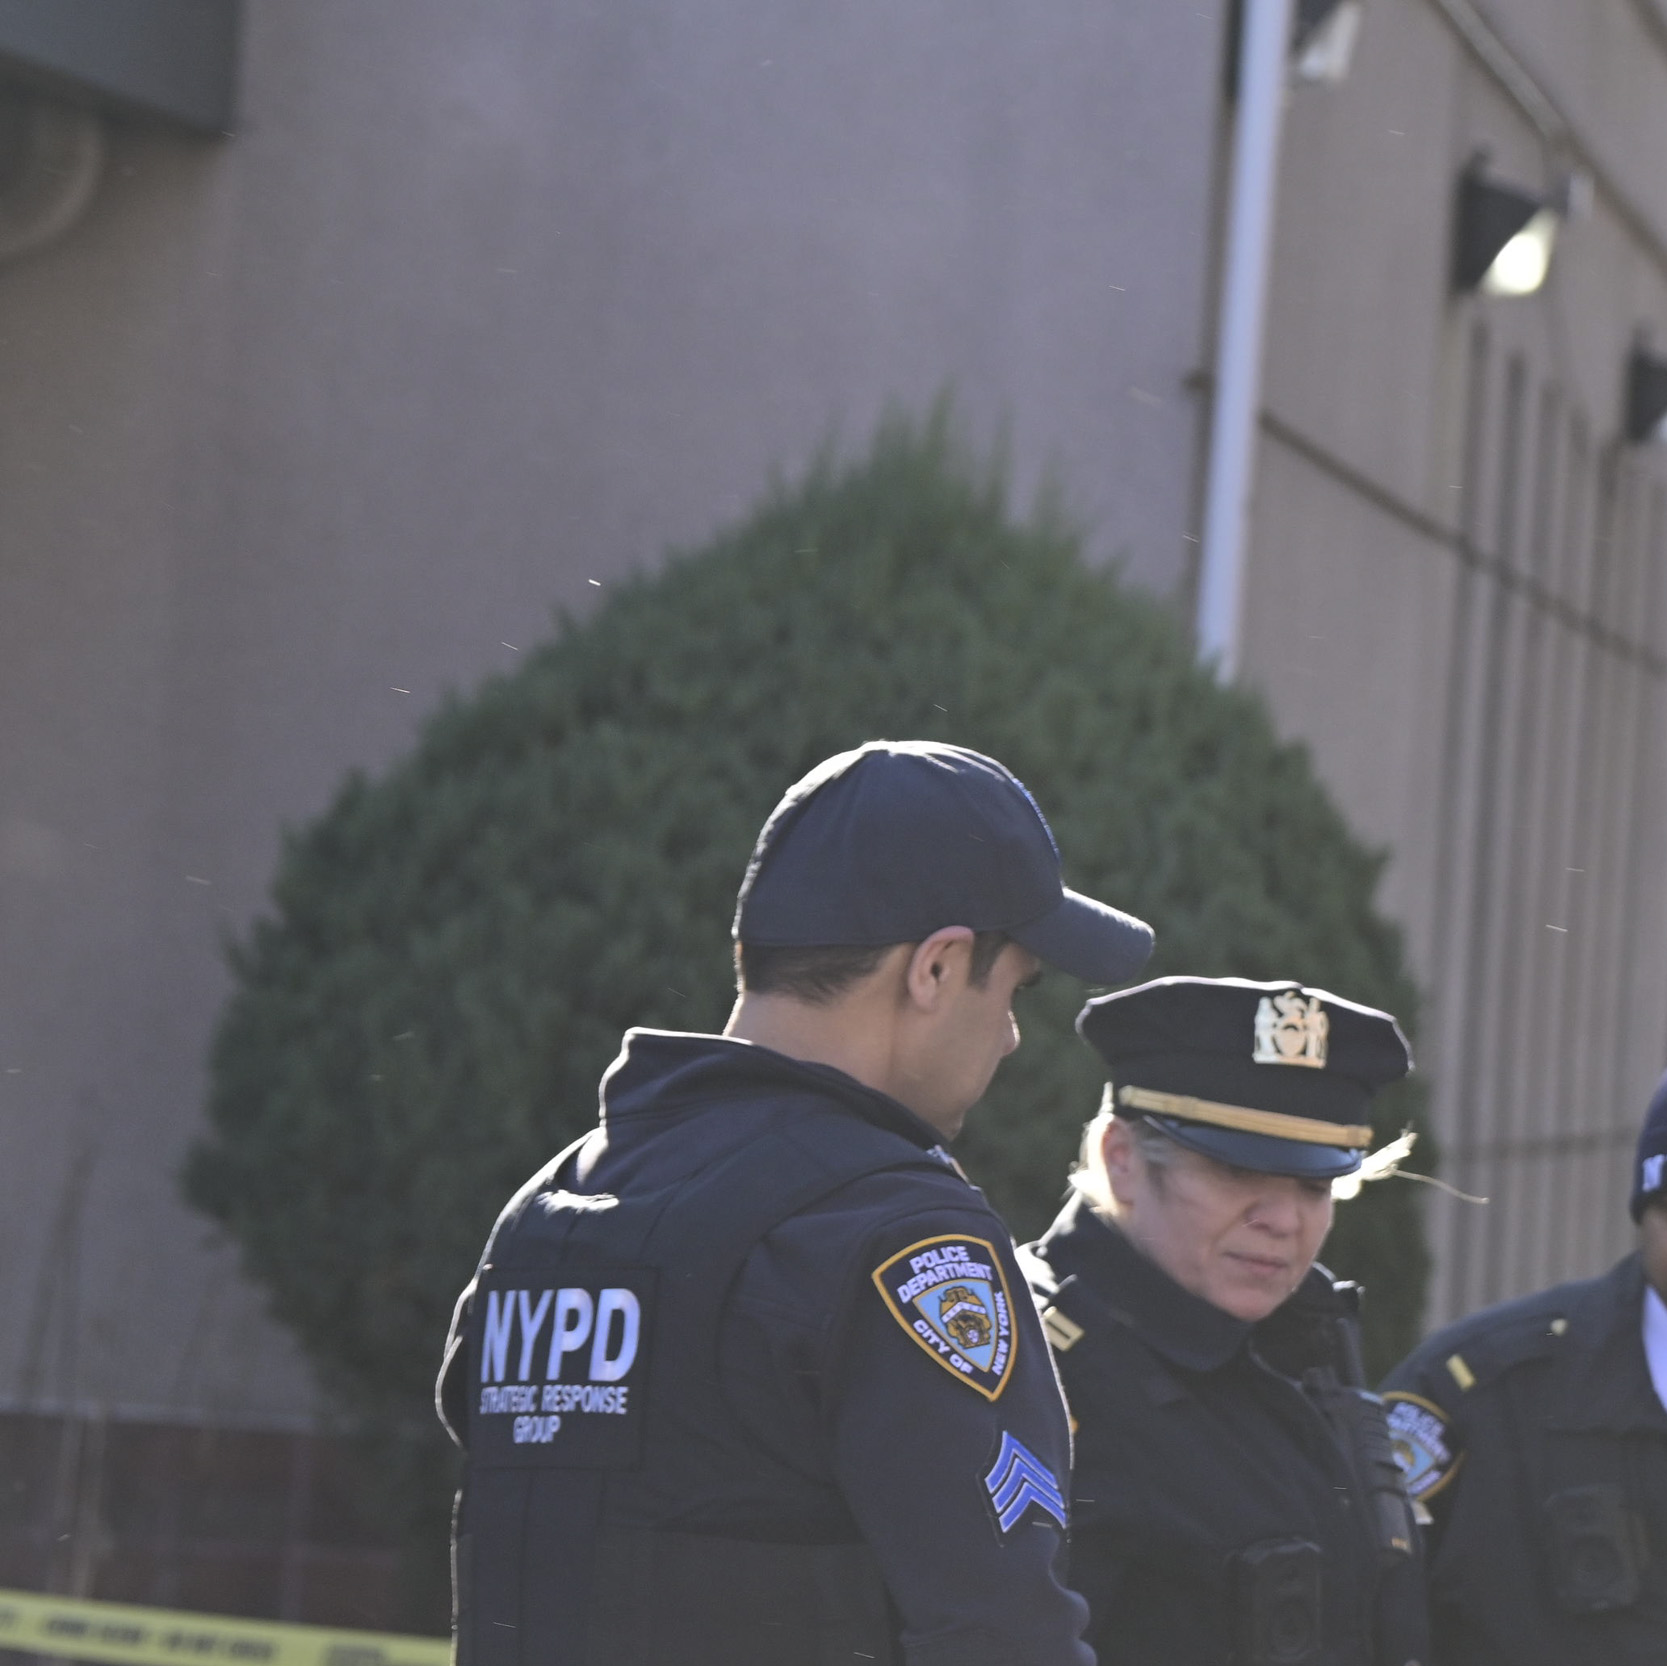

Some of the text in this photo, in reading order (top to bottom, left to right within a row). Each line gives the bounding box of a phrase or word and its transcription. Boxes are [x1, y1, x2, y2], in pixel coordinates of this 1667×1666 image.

[909, 1245, 970, 1274] POLICE
[897, 1261, 993, 1304] DEPARTMENT
[480, 1287, 641, 1383] NYPD
[913, 1319, 974, 1374] CITY OF
[992, 1291, 1009, 1376] NEW YORK
[479, 1384, 629, 1414] STRATEGIC RESPONSE
[513, 1415, 561, 1443] GROUP
